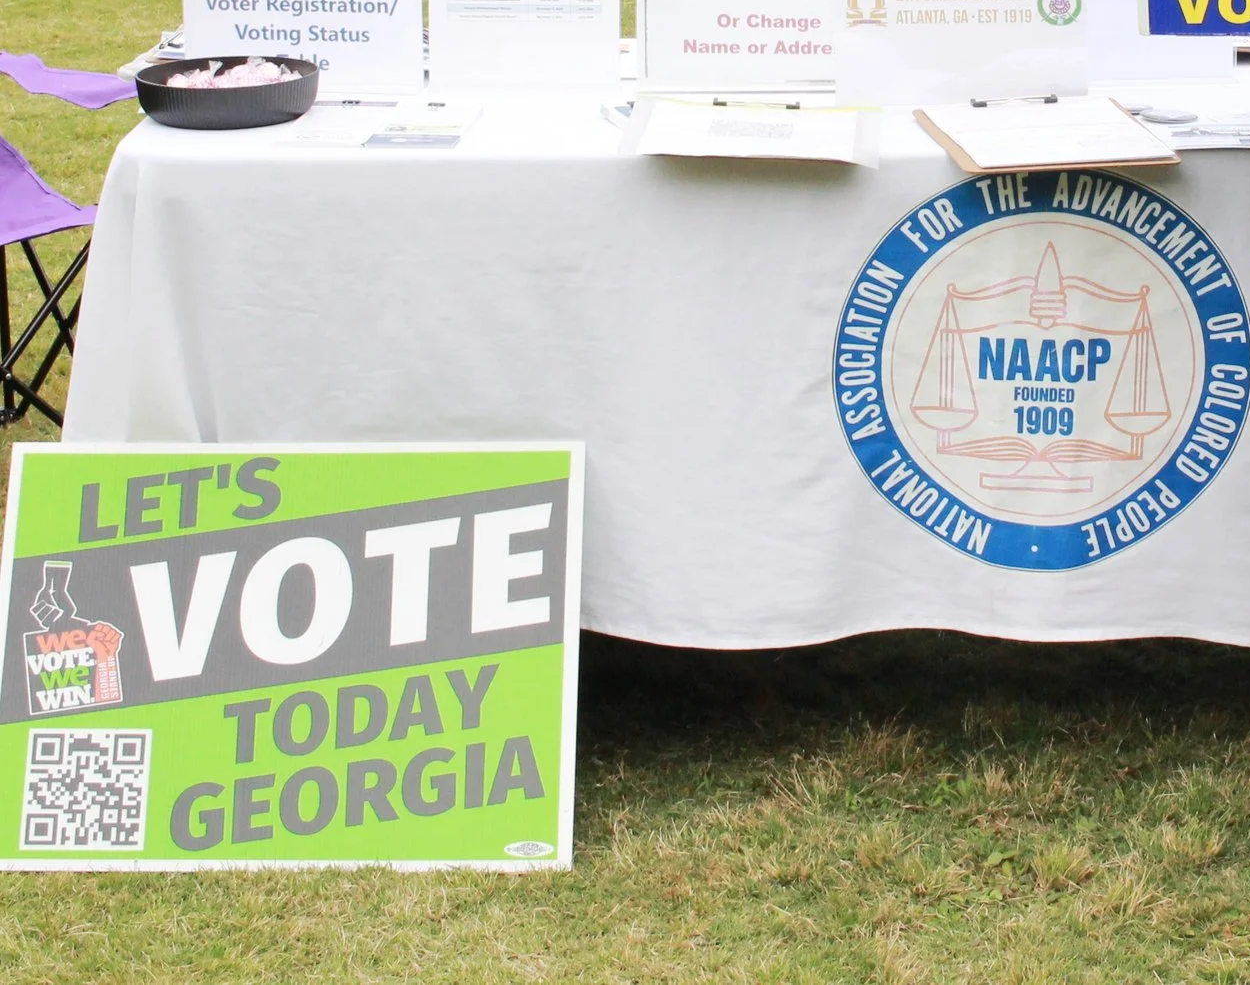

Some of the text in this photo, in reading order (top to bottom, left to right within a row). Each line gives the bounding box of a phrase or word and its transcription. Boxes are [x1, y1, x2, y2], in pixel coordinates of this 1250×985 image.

[717, 13, 821, 32] Or Change
[896, 10, 950, 25] ATLANTA,
[1004, 9, 1033, 24] 1919
[235, 24, 370, 46] Voting Status
[683, 39, 741, 54] Name
[747, 43, 768, 54] or
[839, 172, 1248, 558] NATIONAL ASSOCIATION FOR THE ADVANCEMENT OF COLORED PEOPLE
[978, 336, 1111, 383] NAACP
[1013, 386, 1075, 403] FOUNDED
[1013, 406, 1074, 436] 1909
[78, 457, 282, 544] LET'S
[130, 502, 553, 682] VOTE
[36, 629, 87, 654] we
[40, 665, 90, 690] we
[36, 684, 95, 711] WIN.
[223, 663, 501, 765] TODAY
[169, 735, 546, 852] GEORGIA
